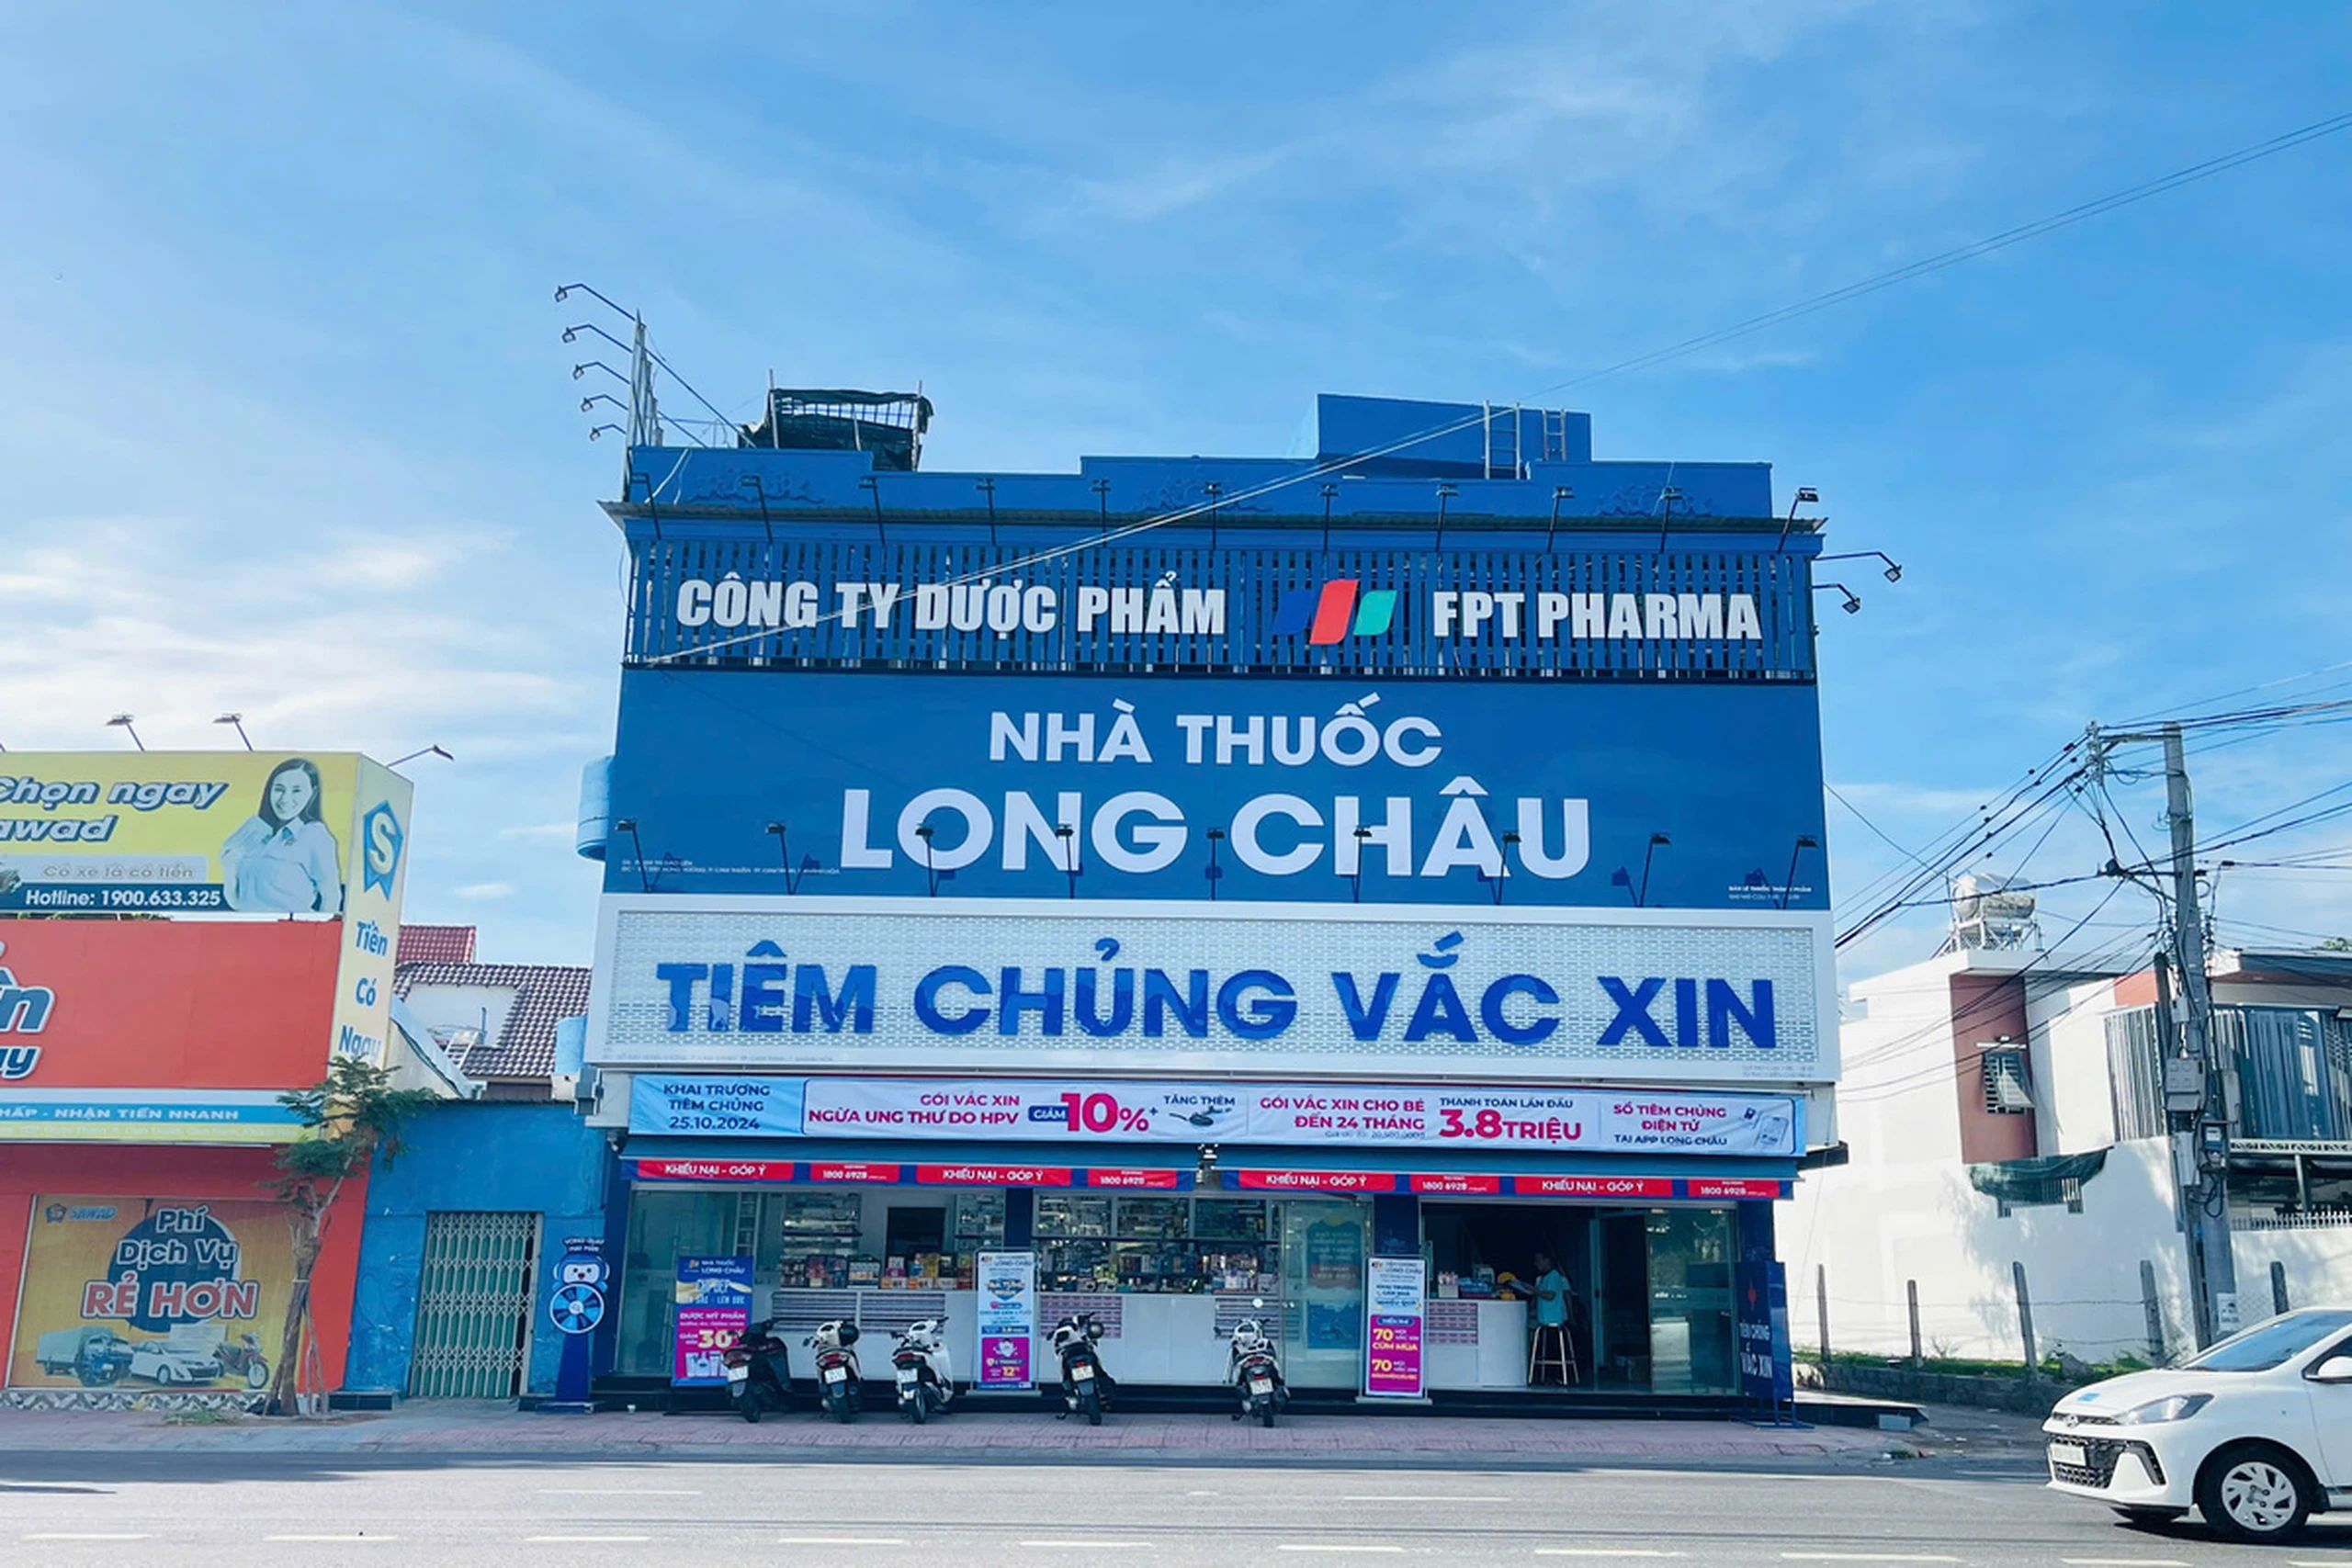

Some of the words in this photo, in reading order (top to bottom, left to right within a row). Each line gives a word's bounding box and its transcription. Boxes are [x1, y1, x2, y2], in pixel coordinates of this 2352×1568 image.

[677, 571, 818, 628] CÔNG
[835, 581, 901, 629] TY
[915, 579, 1057, 640] DƯỢC
[1078, 570, 1226, 635] PHẨM
[1433, 592, 1525, 637] FPT
[1538, 592, 1763, 640] PHARMA
[989, 697, 1153, 764] NHÀ
[1176, 692, 1442, 768] THUỐC
[107, 780, 229, 810] ngay
[840, 787, 1189, 874] LONG
[1230, 775, 1590, 879] CHÂU
[25, 889, 96, 907] Hotline:
[101, 889, 221, 907] 1900.633.325
[356, 920, 389, 957] Tiền
[356, 976, 378, 1008] Có
[656, 940, 877, 1034] TIÊM
[913, 937, 1298, 1041] CHỦNG
[1330, 931, 1561, 1046] VẮC
[1595, 976, 1777, 1049] XIN
[662, 1084, 701, 1096] KHAI
[706, 1082, 771, 1097] TRƯƠNG
[921, 1091, 949, 1107] GÓI
[952, 1090, 989, 1107] VẮC
[990, 1094, 1020, 1107] XIN
[668, 1097, 705, 1111] TIÊM
[1201, 1094, 1237, 1107] THÊM
[1260, 1095, 1289, 1110] GÓI
[1293, 1094, 1329, 1111] VẮC
[1331, 1097, 1360, 1111] XIN
[1363, 1098, 1400, 1111] CHO
[1404, 1096, 1425, 1112] BÉ
[1440, 1097, 1481, 1107] THANH
[1636, 1102, 1671, 1116] TIÊM
[168, 1109, 239, 1121] NHANH
[808, 1107, 862, 1122] NGỪA
[865, 1111, 904, 1123] UNG
[908, 1110, 948, 1124] THƯ
[949, 1111, 977, 1124] DO
[980, 1111, 1020, 1125] HPV
[1060, 1092, 1148, 1133] 10%
[1294, 1111, 1333, 1128] ĐẾN
[1336, 1115, 1360, 1129] 24
[1362, 1113, 1426, 1131] THÁNG
[669, 1116, 761, 1130] 25.10.2024
[1502, 1116, 1582, 1145] TRIỆU
[1634, 1135, 1659, 1145] APP
[1660, 1135, 1692, 1145] LONG
[1693, 1134, 1727, 1146] CHÂU
[729, 1163, 756, 1177] GÓP
[1007, 1169, 1035, 1182] GÓP
[1329, 1174, 1357, 1187] GÓP
[1607, 1179, 1634, 1192] GÓP
[155, 1203, 209, 1234] Phí
[117, 1239, 187, 1270] Dịch
[196, 1239, 240, 1269] Vụ
[81, 1271, 140, 1320] RẺ
[150, 1278, 259, 1320] HƠN
[1373, 1328, 1394, 1342] 70
[1372, 1359, 1393, 1372] 70
